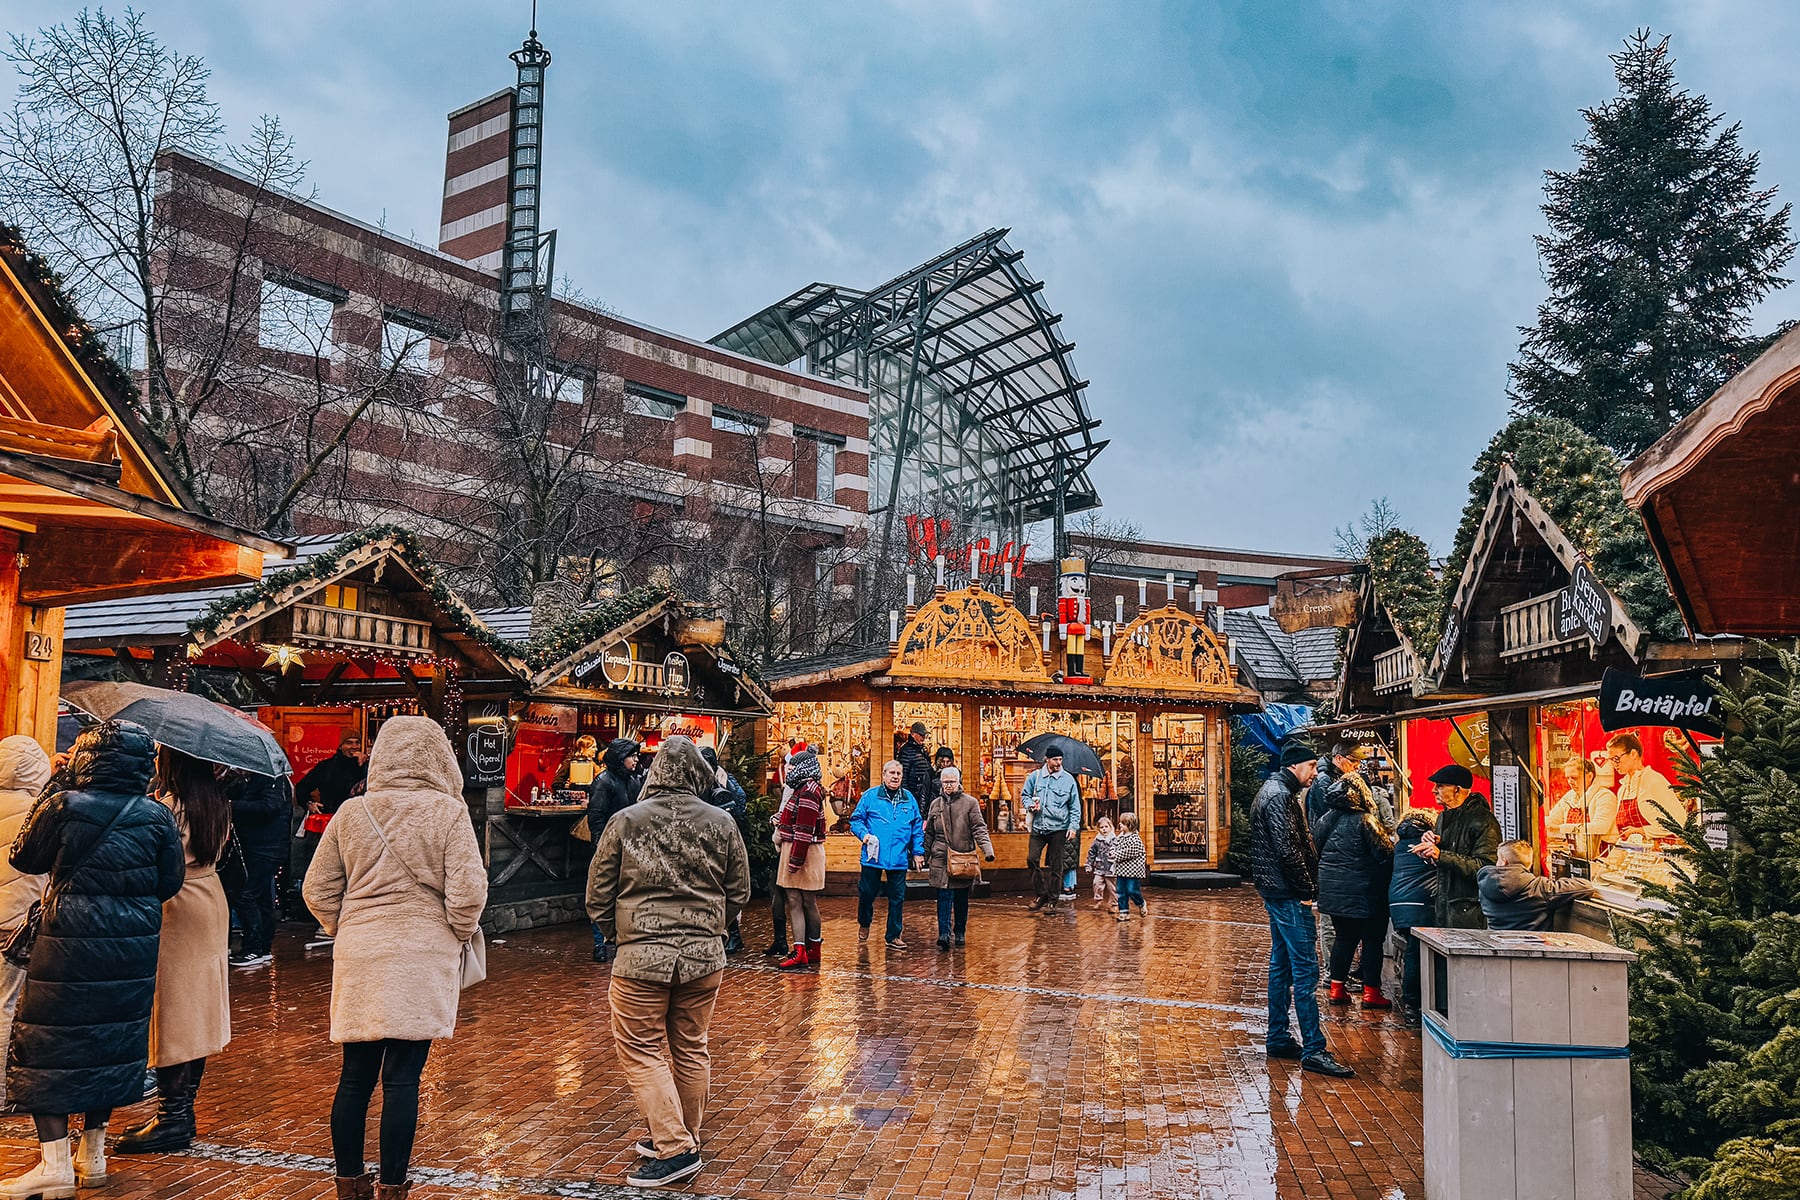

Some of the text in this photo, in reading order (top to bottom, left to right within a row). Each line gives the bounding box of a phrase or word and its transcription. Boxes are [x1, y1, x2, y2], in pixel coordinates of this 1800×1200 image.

[1572, 585, 1603, 642] knödel
[30, 634, 52, 657] 24
[1615, 689, 1713, 721] Bratäpfel
[668, 722, 705, 738] Raclette
[1142, 723, 1152, 733] 26
[483, 738, 496, 749] Hot
[479, 753, 501, 766] Aperol
